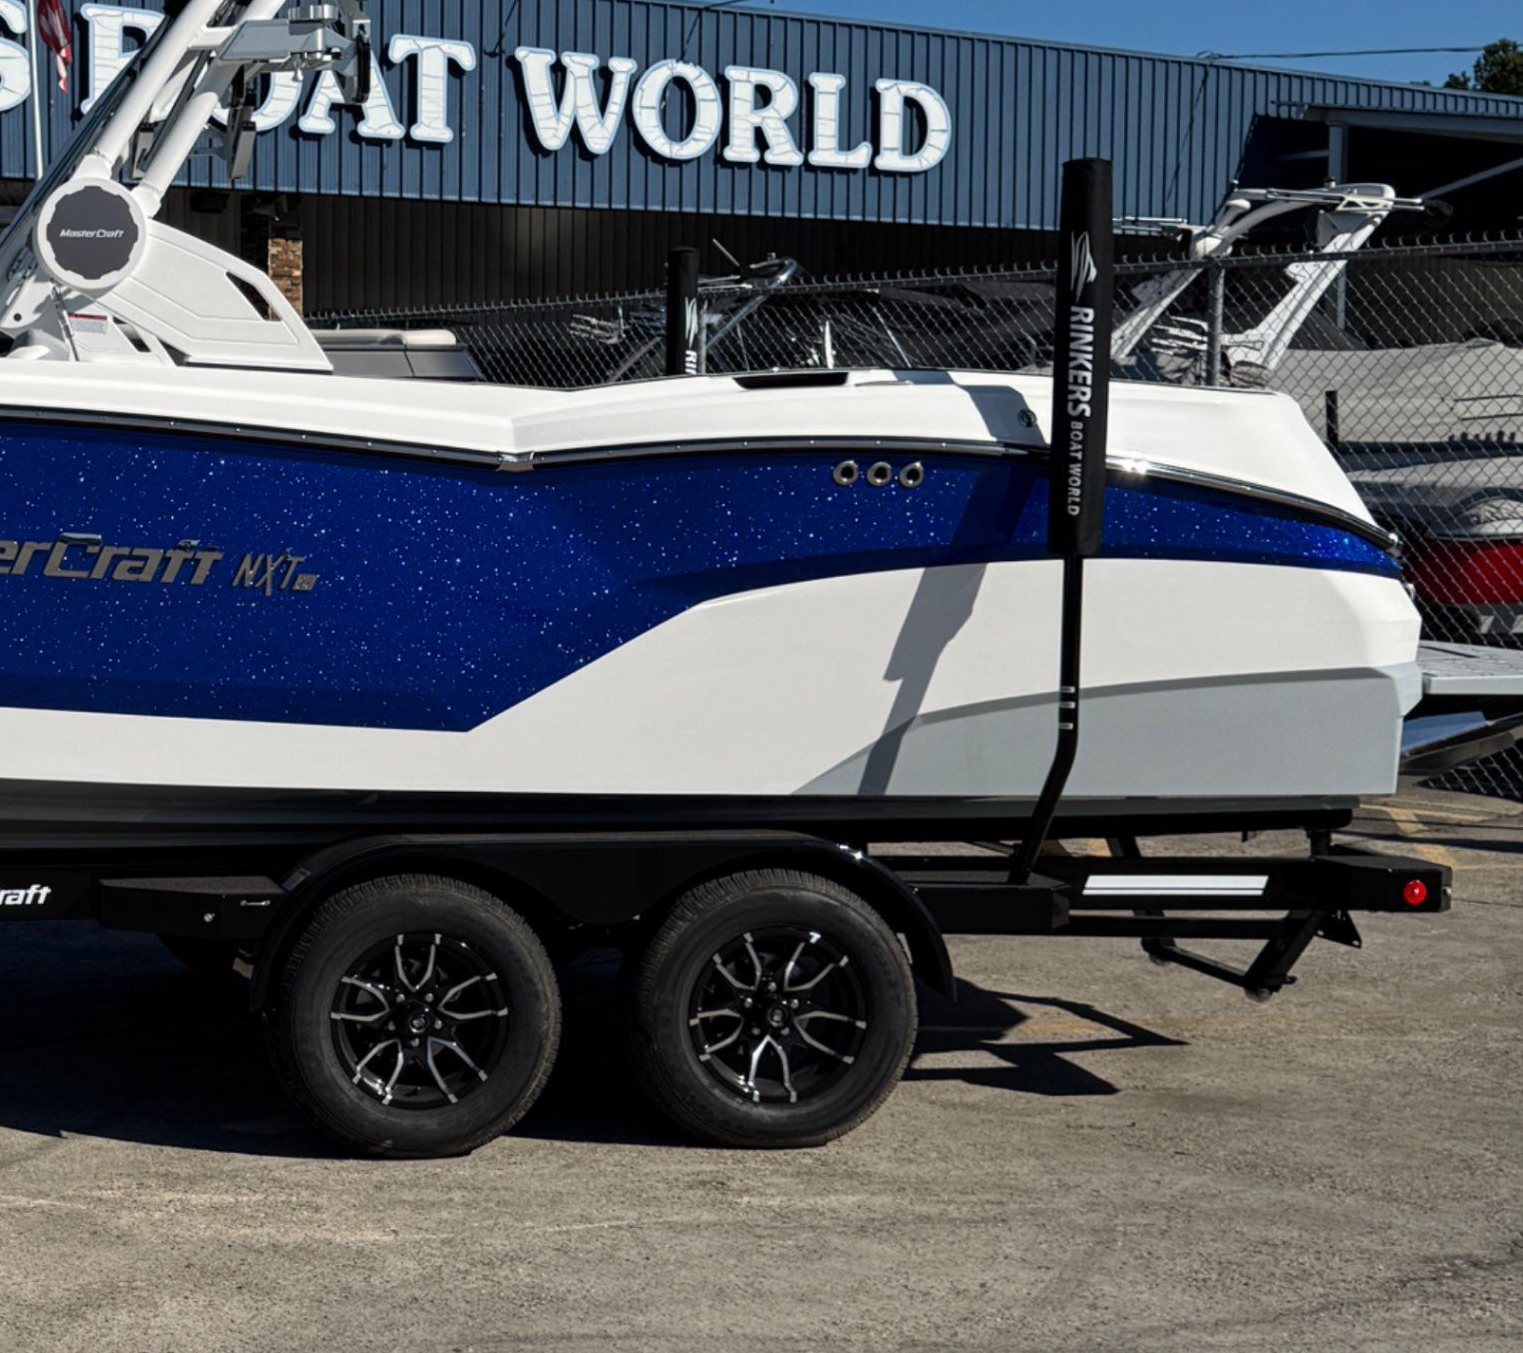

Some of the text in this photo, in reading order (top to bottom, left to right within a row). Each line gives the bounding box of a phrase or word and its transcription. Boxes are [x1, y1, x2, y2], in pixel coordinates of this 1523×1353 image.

[514, 46, 952, 173] WORLD
[59, 229, 124, 238] MasterCraft
[1066, 306, 1095, 516] RINKERS BOAT WORLD
[232, 551, 307, 596] NXT
